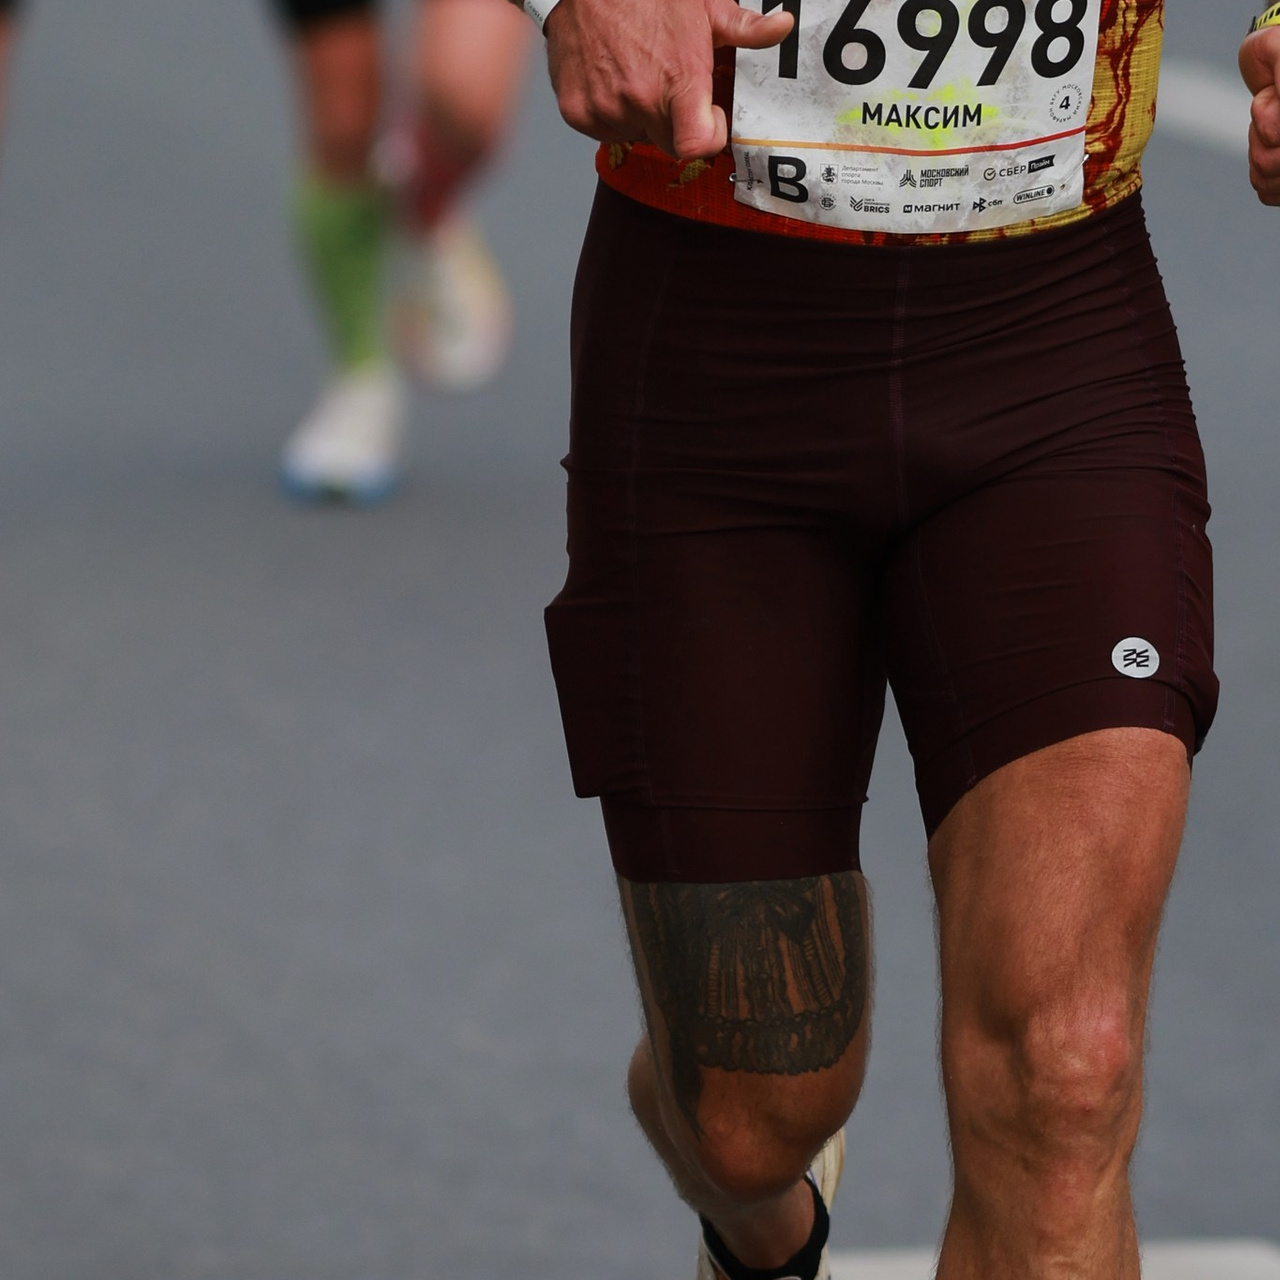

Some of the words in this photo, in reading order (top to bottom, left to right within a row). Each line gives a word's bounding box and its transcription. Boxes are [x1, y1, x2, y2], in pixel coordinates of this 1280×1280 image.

[1059, 95, 1071, 110] 4
[861, 101, 982, 130] МАКСИМ
[919, 165, 969, 178] МОСКОВСКИЙ
[999, 165, 1027, 177] СБЕР
[919, 178, 943, 188] СПОРТ
[1016, 189, 1046, 202] WINLINE
[863, 205, 890, 213] BRICS
[914, 203, 960, 213] магнит
